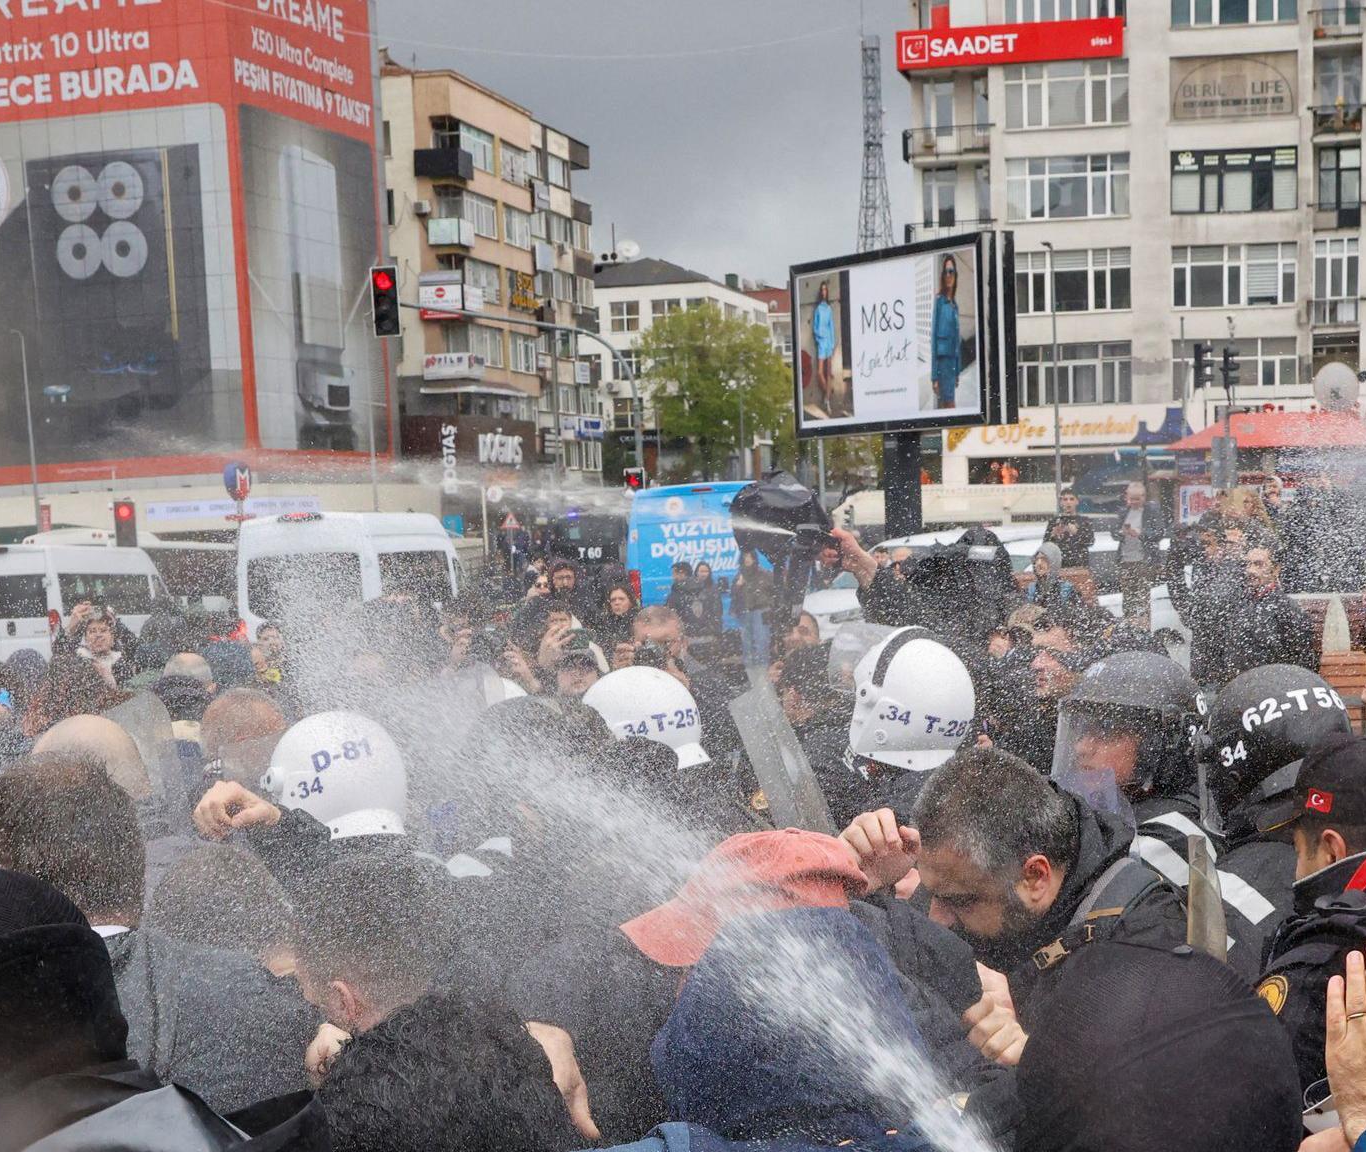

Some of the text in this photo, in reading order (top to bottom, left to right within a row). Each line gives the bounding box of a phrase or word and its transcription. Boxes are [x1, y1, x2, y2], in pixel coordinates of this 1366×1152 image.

[50, 32, 79, 58] 10
[87, 28, 150, 54] Ultra
[251, 26, 354, 86] X50 Ultra Complete
[930, 33, 1018, 58] SAADET
[60, 59, 199, 101] BURADA
[1250, 80, 1284, 95] LIFE
[324, 91, 333, 114] 9
[861, 299, 905, 334] M&S
[981, 418, 1048, 445] Coffee
[588, 547, 603, 559] 60
[887, 705, 974, 738] 34 T-28
[311, 737, 372, 773] D-81
[1221, 740, 1248, 768] 34
[297, 776, 324, 799] 34
